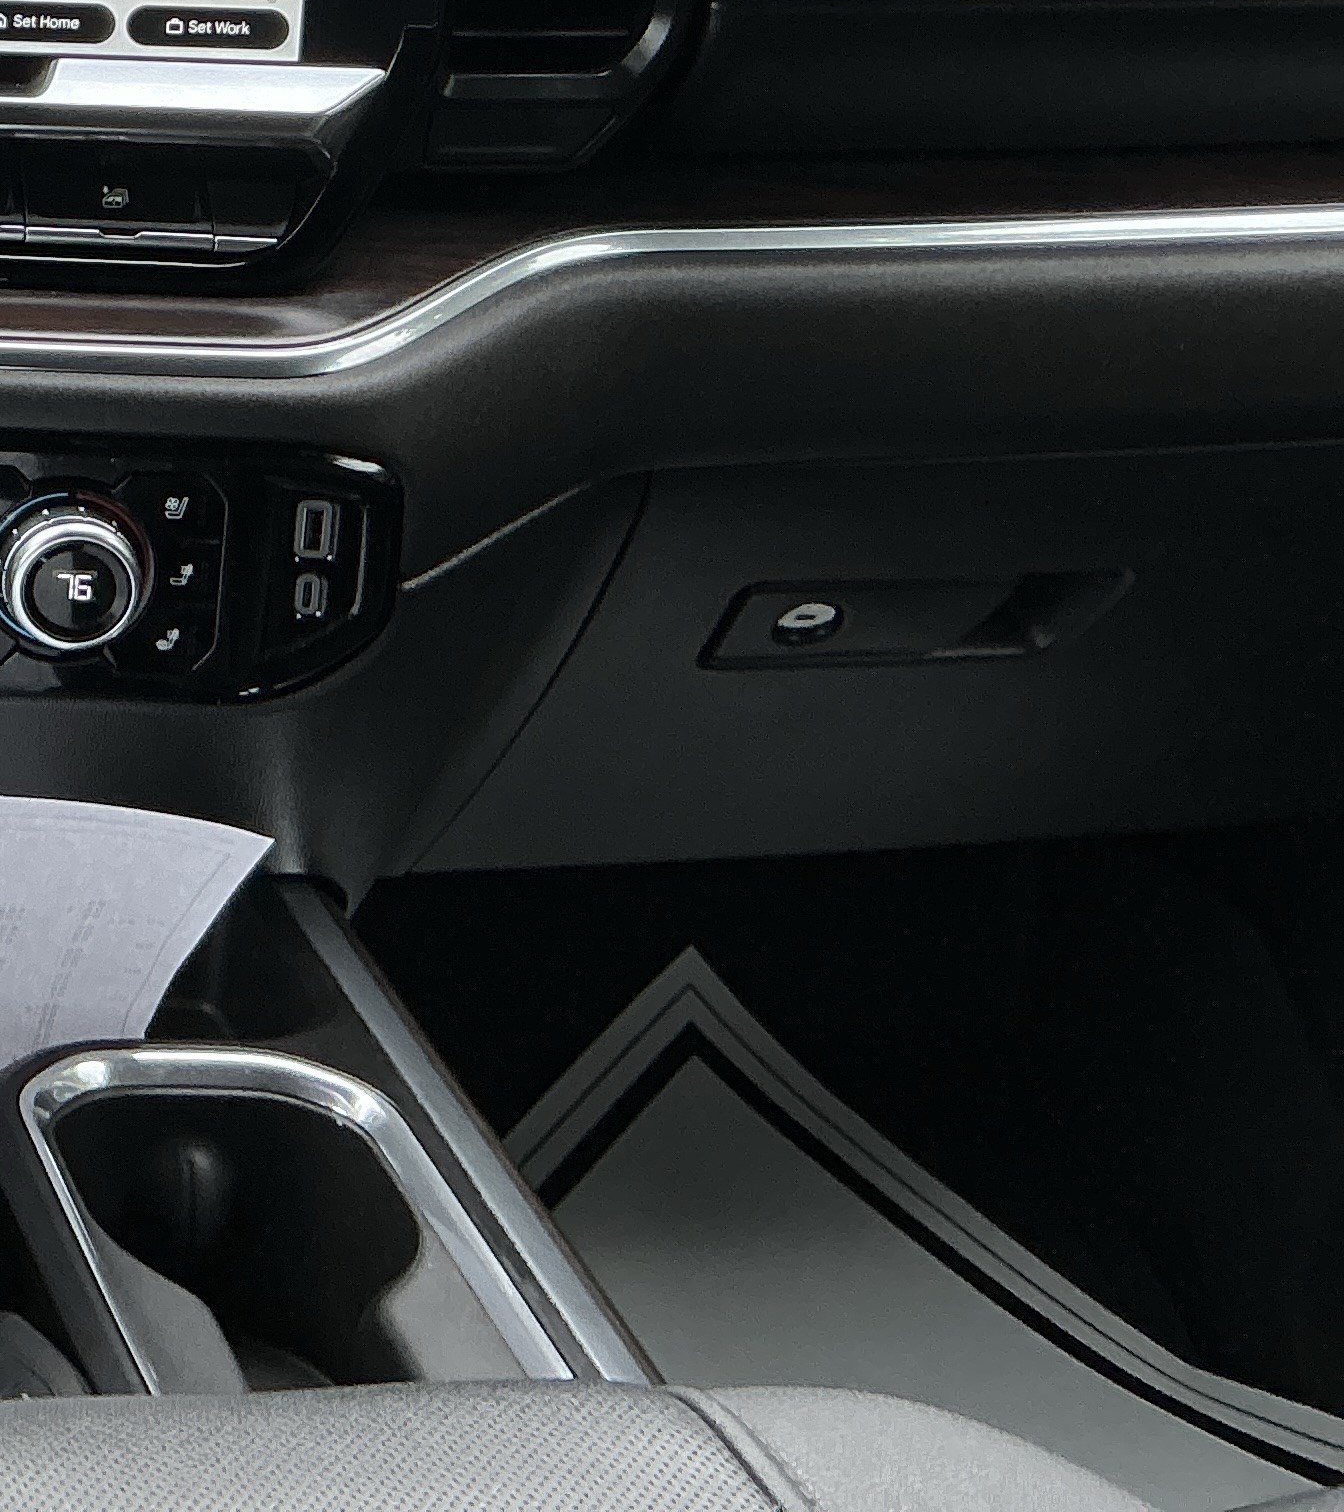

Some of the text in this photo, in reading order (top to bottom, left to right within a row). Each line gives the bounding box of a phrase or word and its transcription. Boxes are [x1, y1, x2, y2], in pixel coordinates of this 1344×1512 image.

[13, 15, 79, 31] Set Home
[188, 20, 250, 36] Set Work
[57, 573, 92, 600] 76
